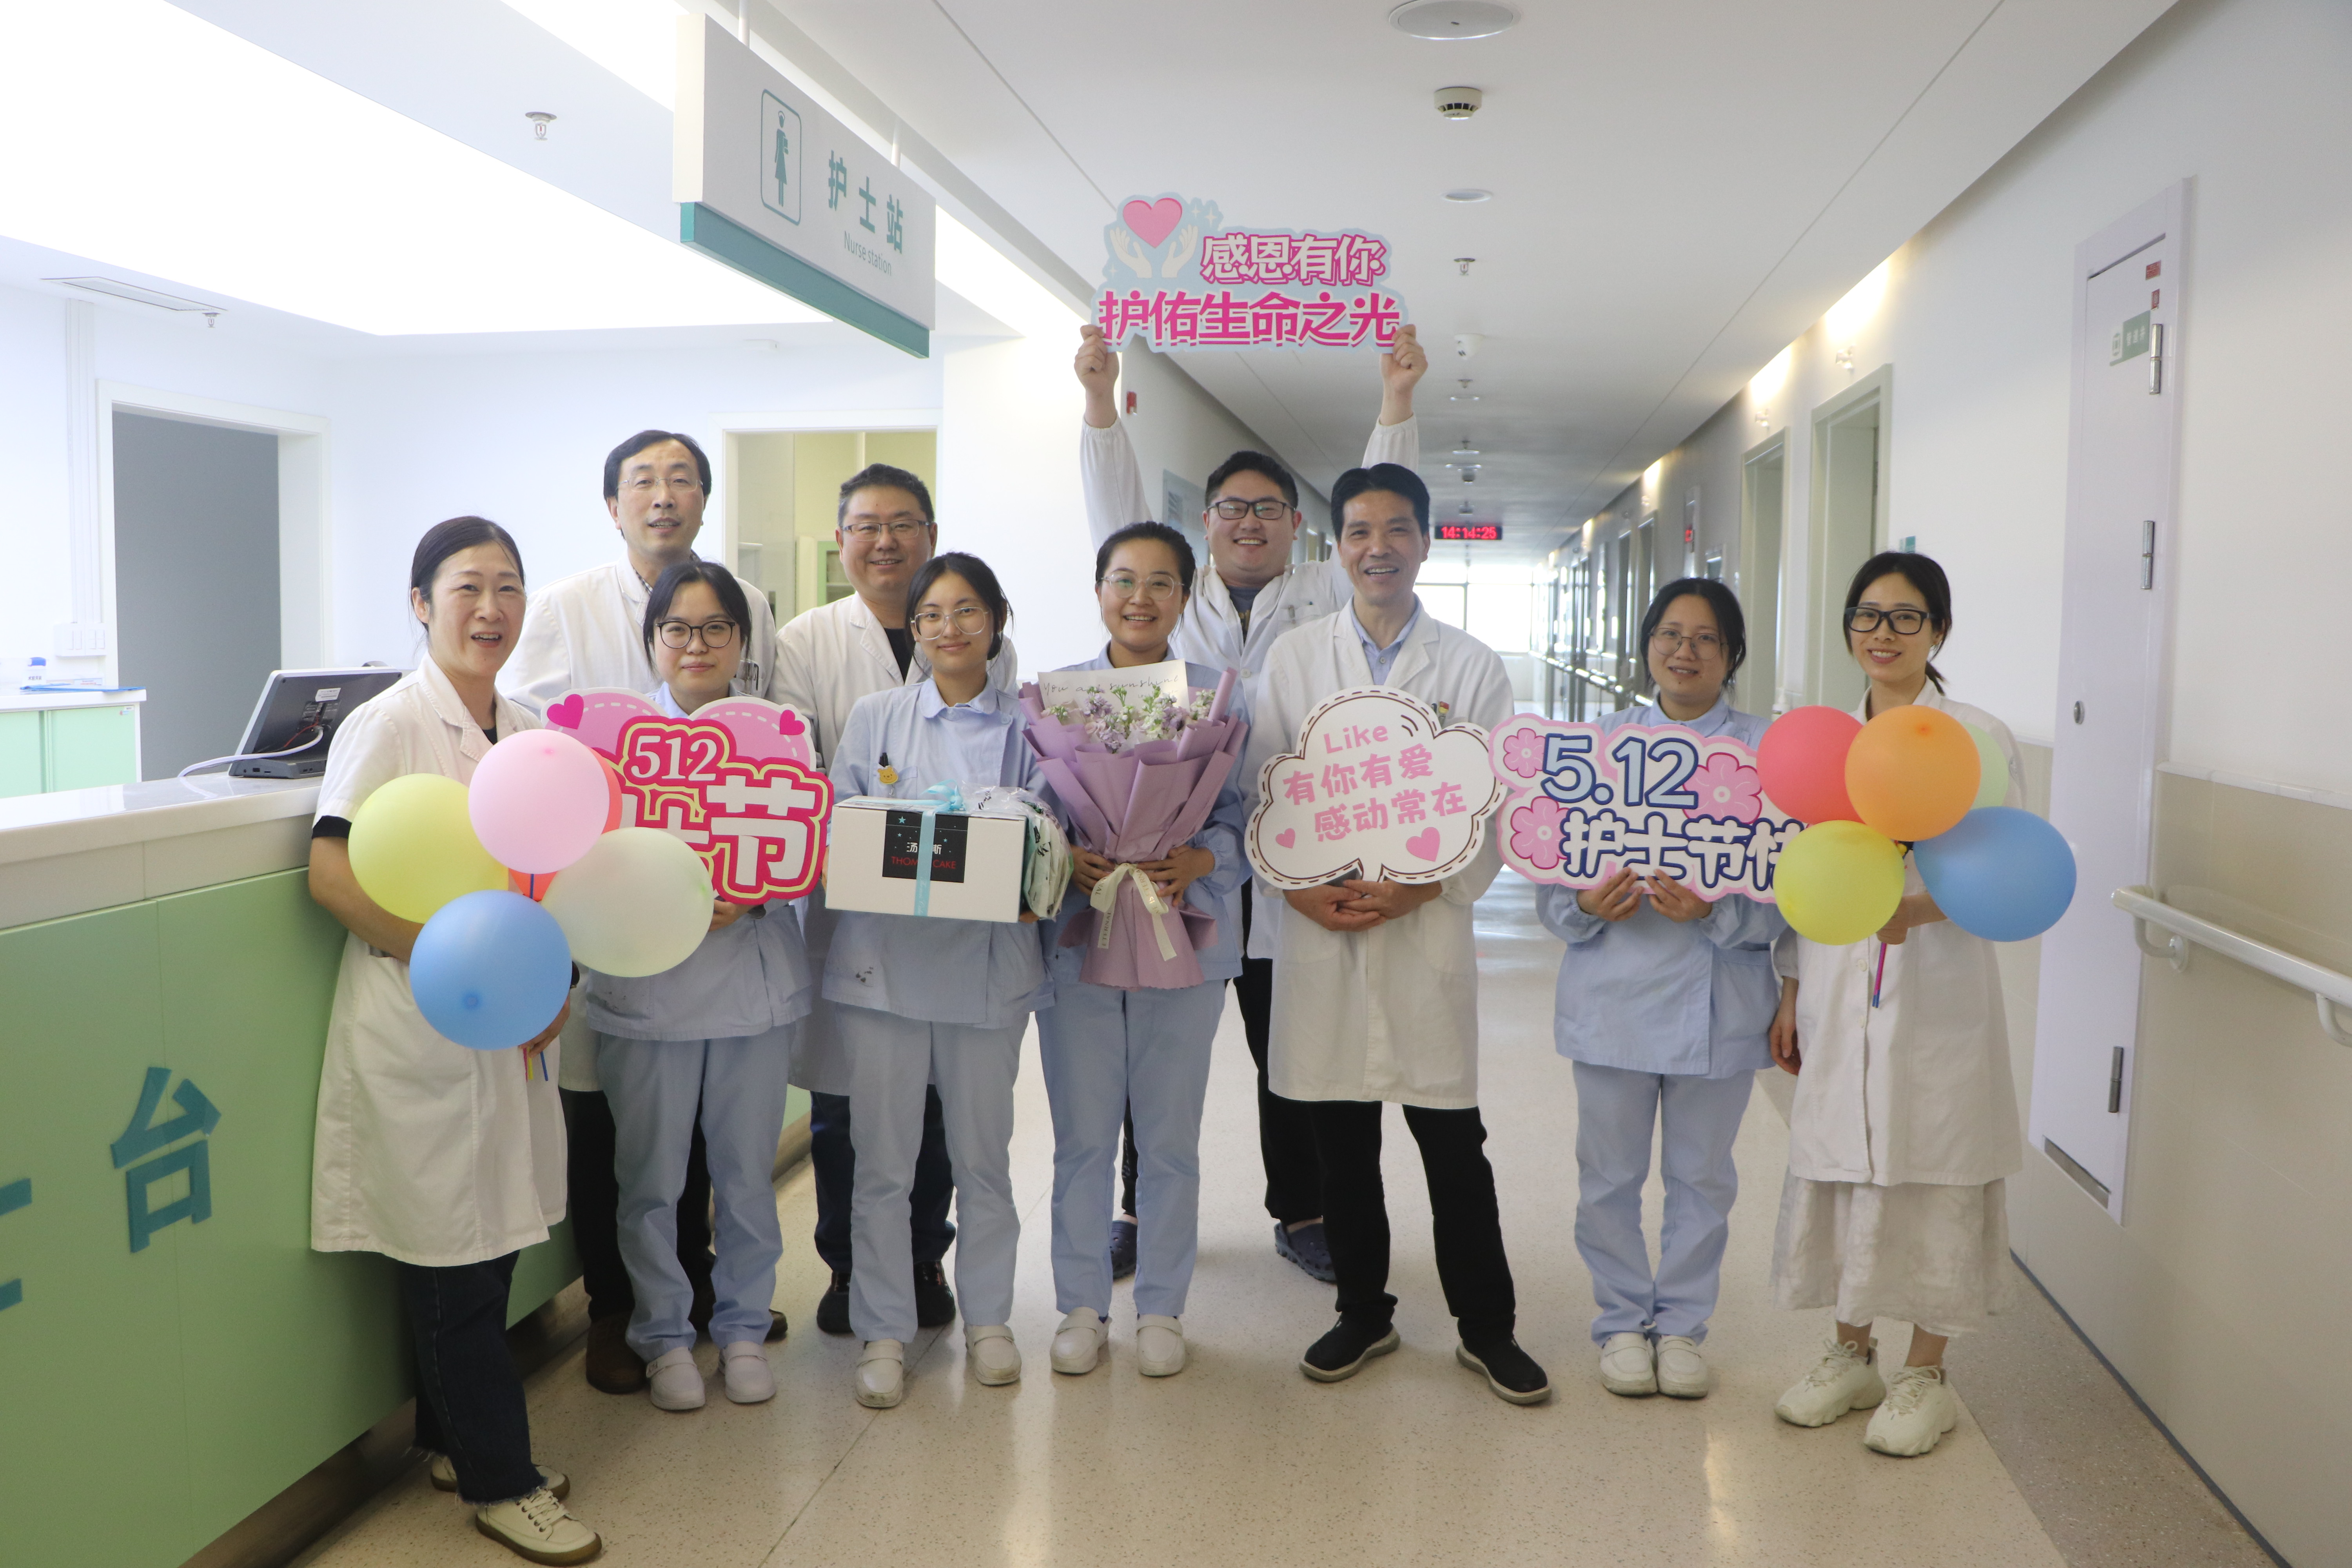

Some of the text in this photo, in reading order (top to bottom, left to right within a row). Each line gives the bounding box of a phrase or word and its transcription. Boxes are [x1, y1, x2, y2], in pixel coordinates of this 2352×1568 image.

[828, 150, 904, 254] 护士站
[844, 230, 892, 276] Nurse station
[1200, 233, 1387, 286] 感恩有你
[1098, 290, 1400, 347] 护佑生命之光
[1441, 526, 1497, 540] 14:14:25
[1044, 682, 1068, 696] You
[631, 735, 717, 782] 512
[1323, 724, 1388, 754] Like
[1283, 743, 1433, 806] 有你有爱
[1541, 733, 1699, 809] 5.12
[1314, 782, 1467, 842] 感动常在
[891, 856, 956, 869] THOM CAKE
[906, 842, 942, 855] 汤斯
